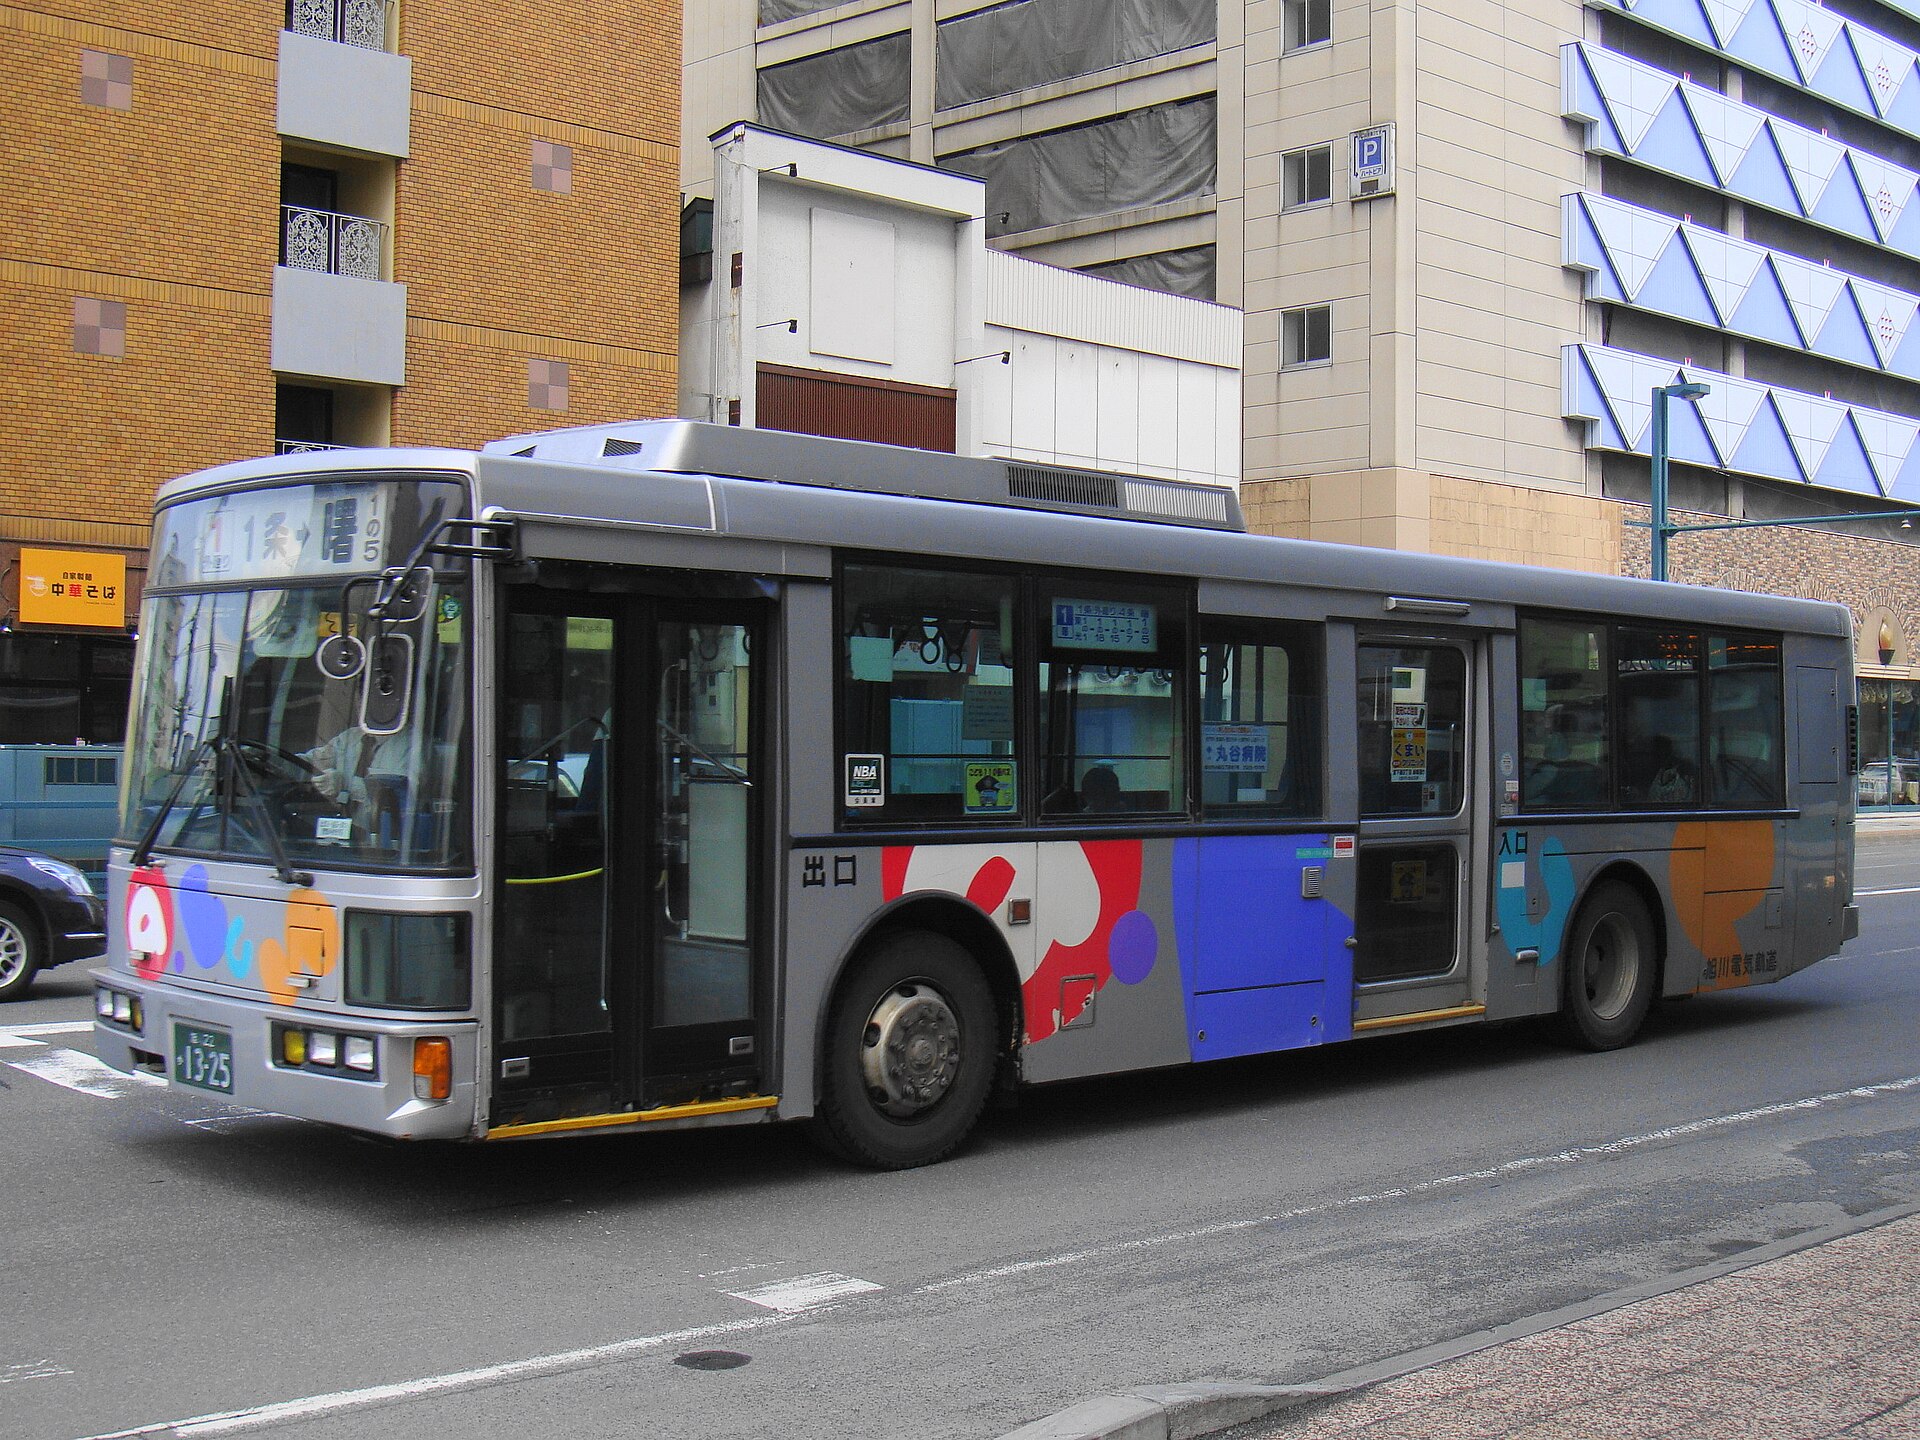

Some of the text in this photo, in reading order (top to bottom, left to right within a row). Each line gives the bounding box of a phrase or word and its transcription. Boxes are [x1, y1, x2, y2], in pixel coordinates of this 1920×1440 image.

[1363, 140, 1378, 165] P
[51, 583, 116, 599] 中華そば
[853, 765, 877, 777] NBA
[1498, 831, 1528, 855] 入口
[803, 855, 857, 888] 出口
[184, 1045, 231, 1088] 13-25
